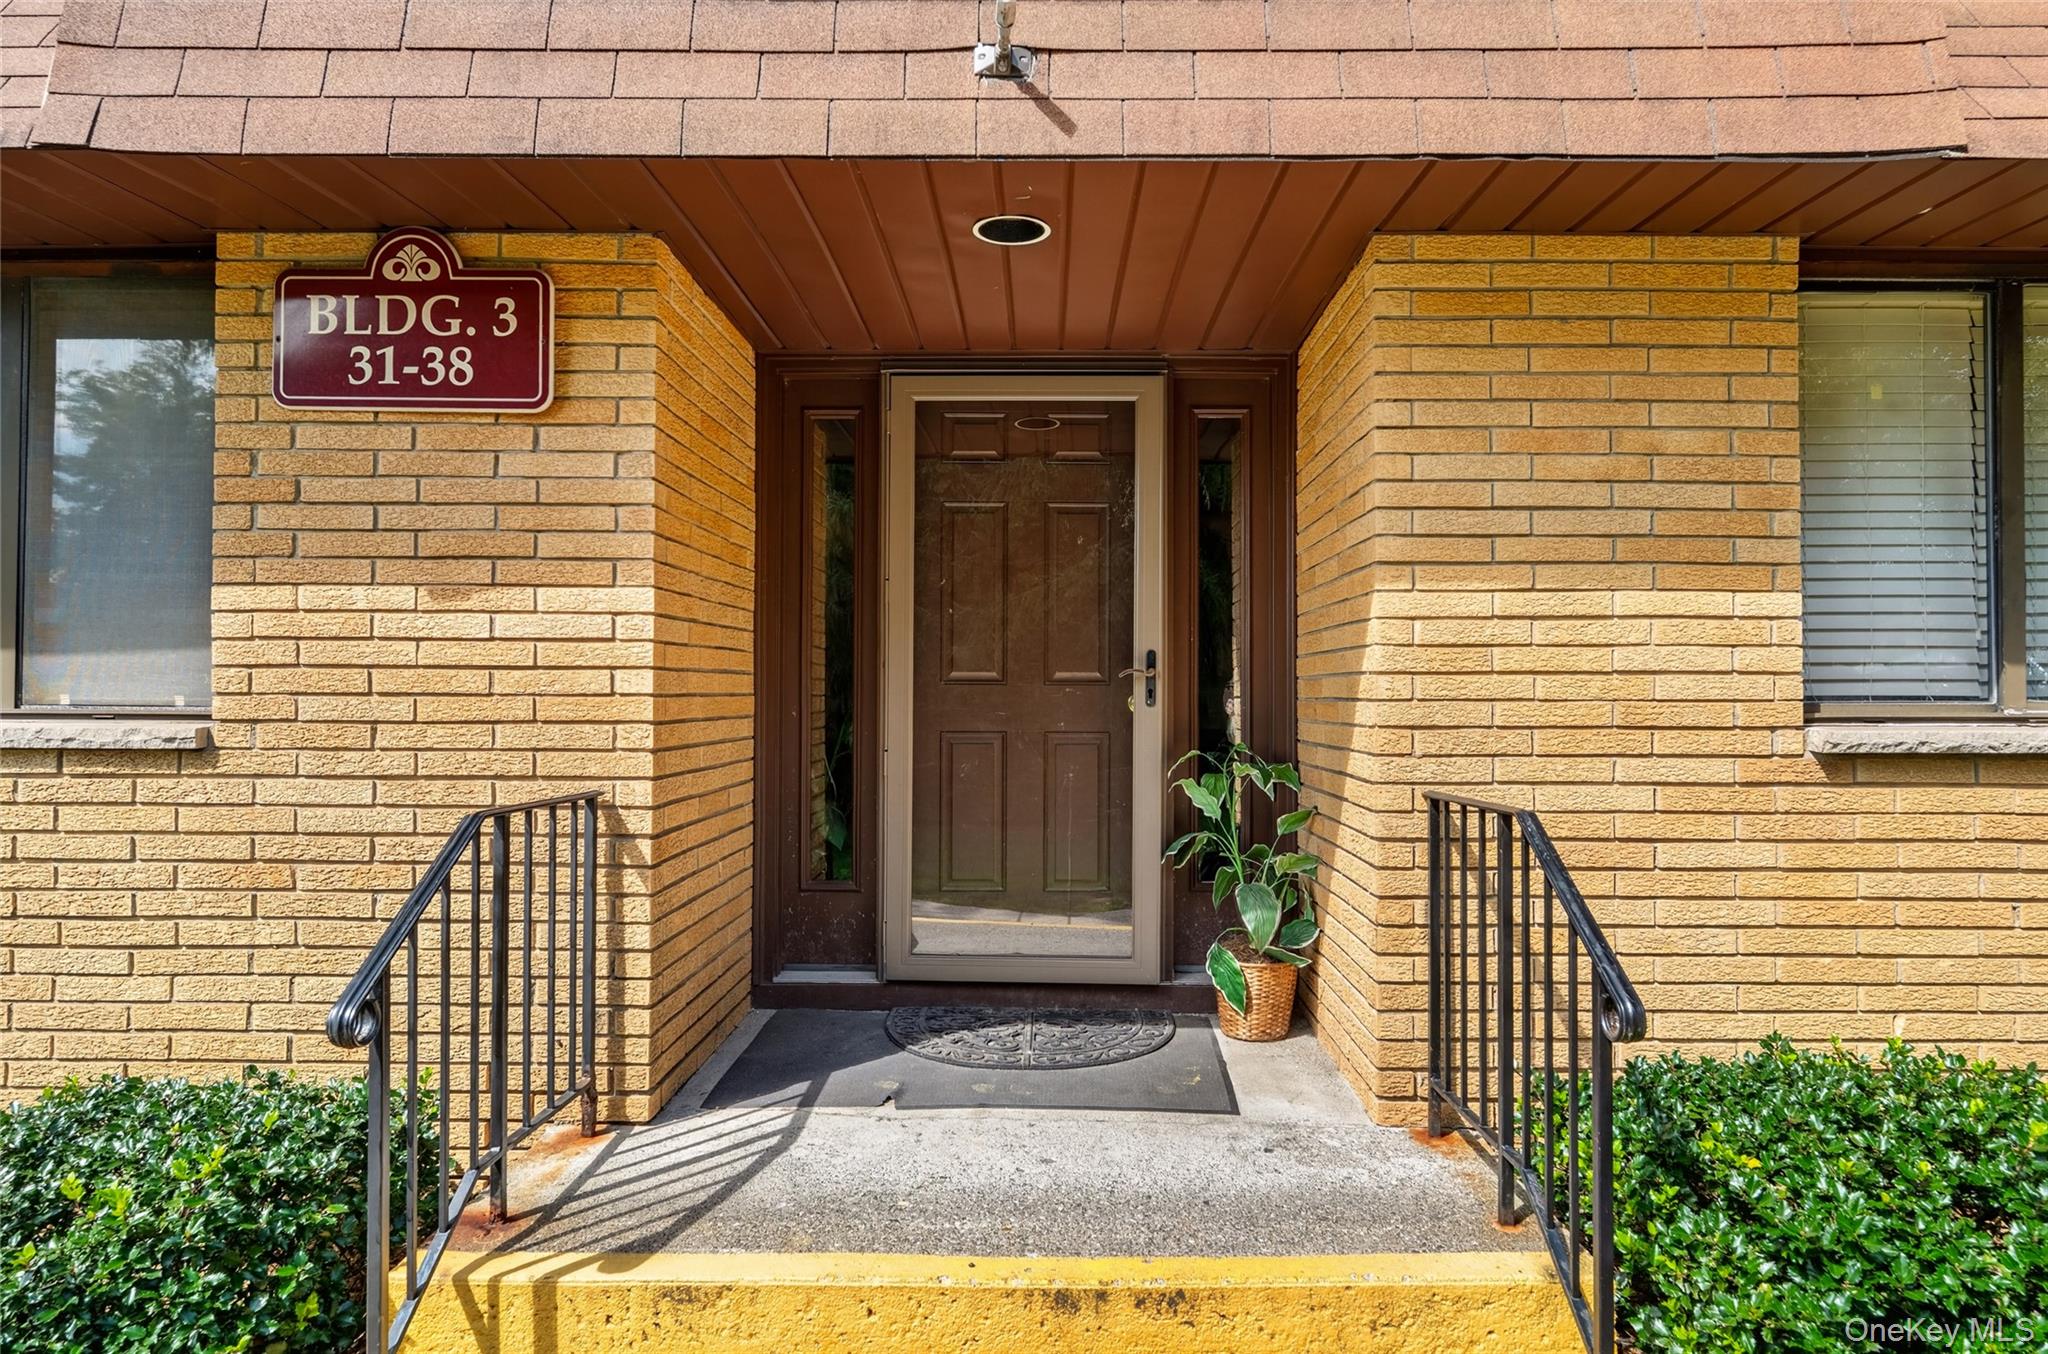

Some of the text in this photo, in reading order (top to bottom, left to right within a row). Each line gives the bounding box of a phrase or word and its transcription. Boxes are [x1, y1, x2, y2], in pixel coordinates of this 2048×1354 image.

[306, 294, 518, 337] BLDG. 3
[347, 345, 474, 386] 31-38
